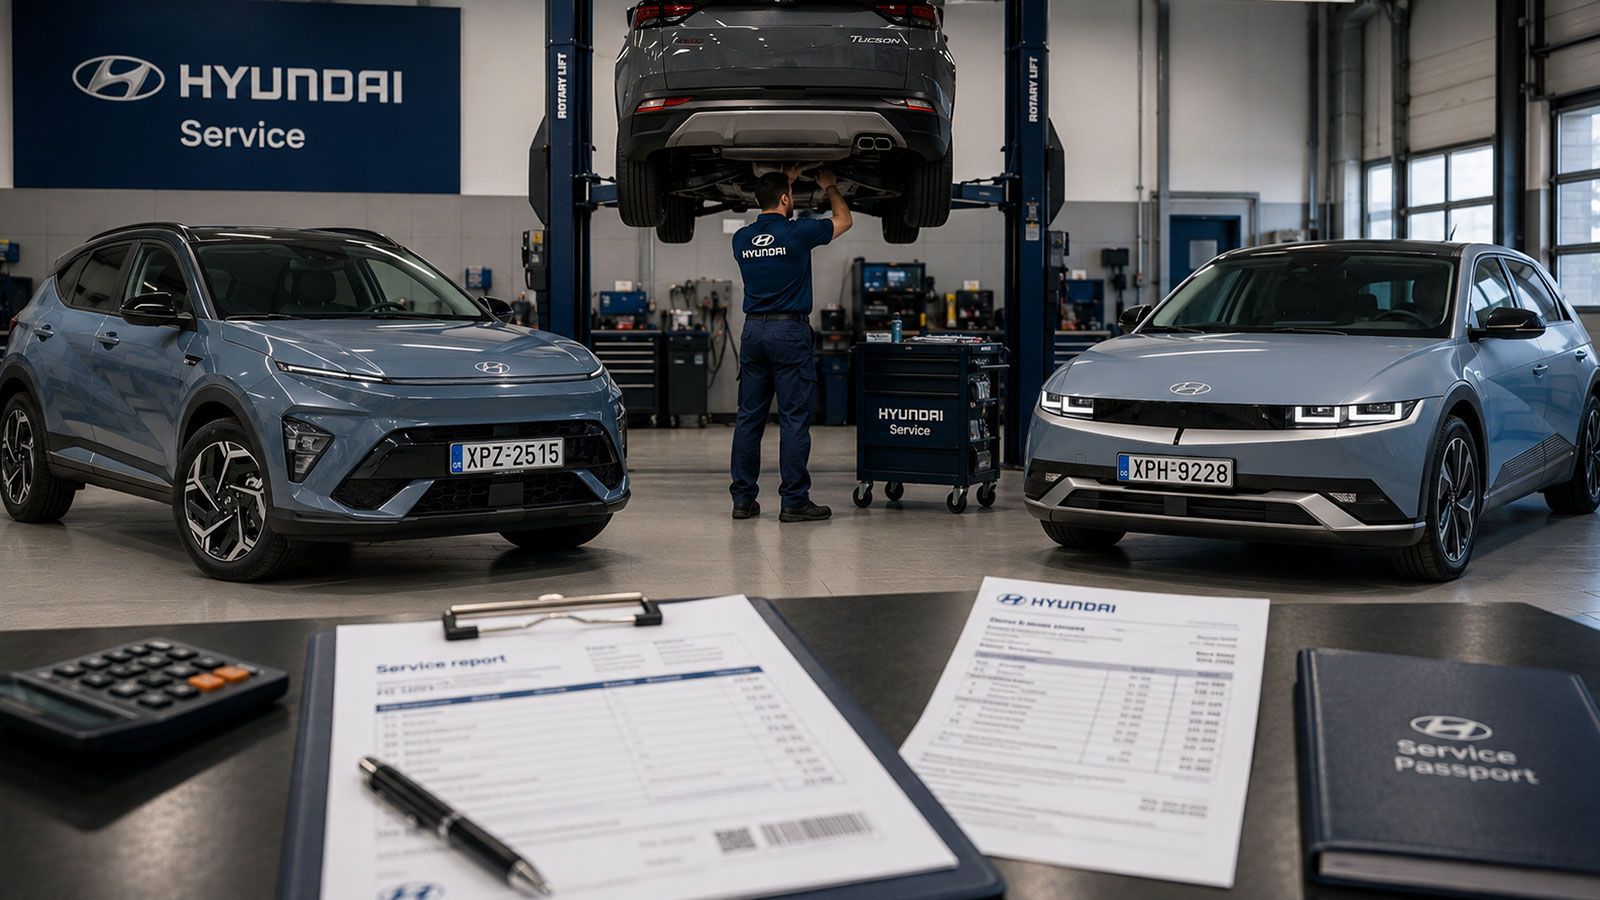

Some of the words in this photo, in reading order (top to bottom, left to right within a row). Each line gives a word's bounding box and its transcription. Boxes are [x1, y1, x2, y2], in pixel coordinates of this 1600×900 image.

[850, 35, 901, 44] TUCSON
[557, 52, 567, 76] LIFT
[1029, 56, 1038, 79] LIFT
[179, 63, 403, 104] HYUNDAI
[557, 76, 567, 119] ROTARY
[1028, 80, 1038, 122] ROTARY
[180, 119, 306, 149] Service
[742, 247, 787, 259] HYUNDAI
[878, 407, 944, 421] HYUNDAI
[889, 423, 931, 436] Service
[467, 443, 559, 469] XPZ-2515
[1133, 459, 1228, 483] XPH-9228
[1030, 596, 1117, 614] HYUNDAI
[376, 661, 446, 674] Service
[450, 654, 507, 668] report
[1396, 738, 1518, 765] Service
[1394, 755, 1540, 785] Passport
